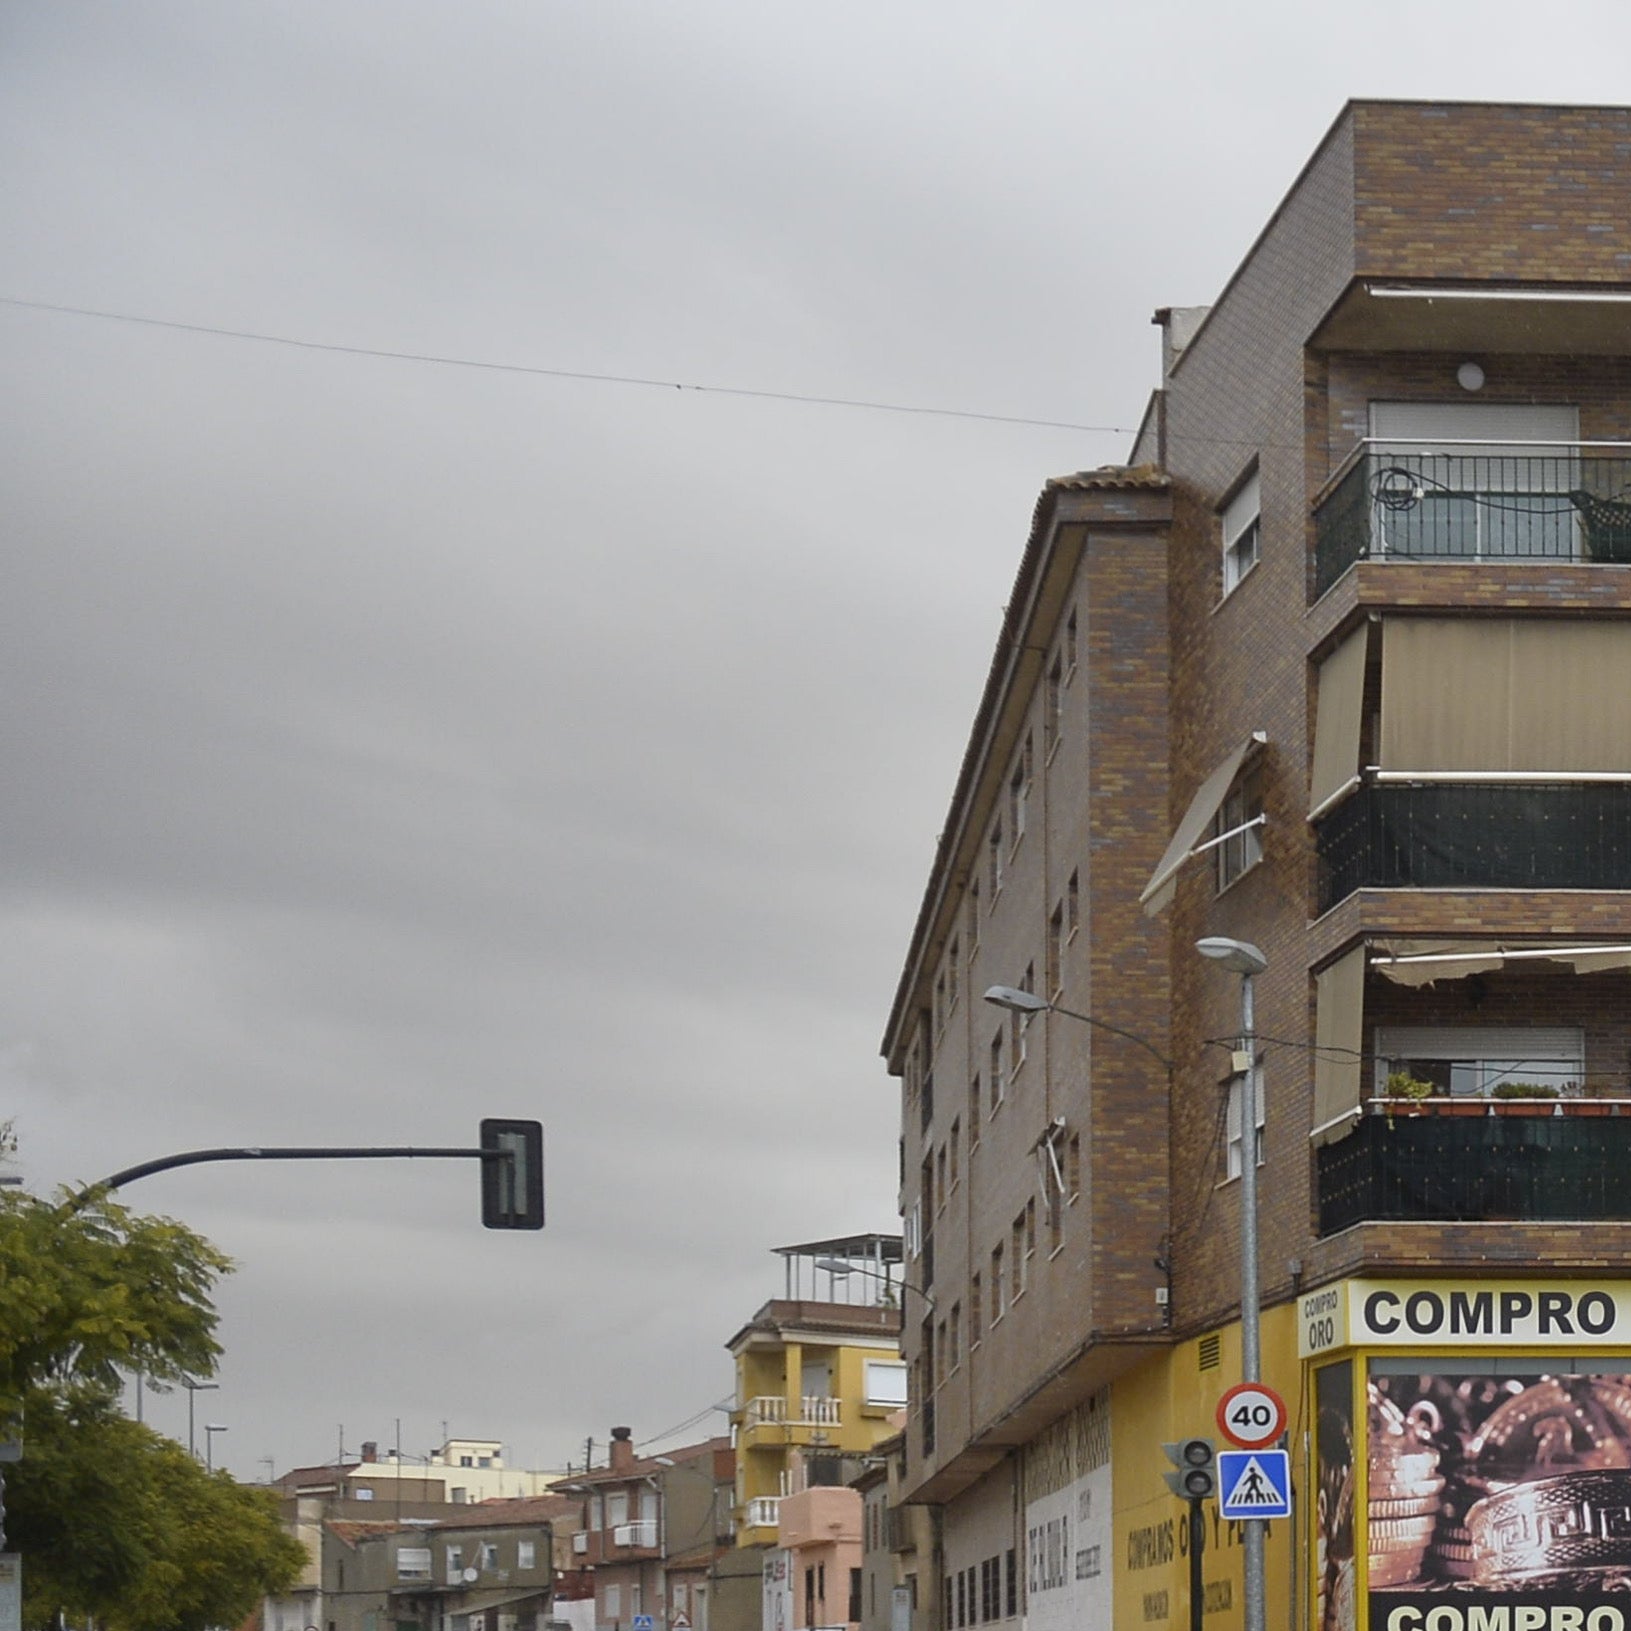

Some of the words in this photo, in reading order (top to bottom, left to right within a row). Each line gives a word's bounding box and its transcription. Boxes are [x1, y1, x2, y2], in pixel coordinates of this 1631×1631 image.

[1304, 1289, 1338, 1319] COMPRO
[1363, 1291, 1617, 1336] COMPRO
[1309, 1316, 1334, 1350] ORO
[1232, 1405, 1271, 1427] 40
